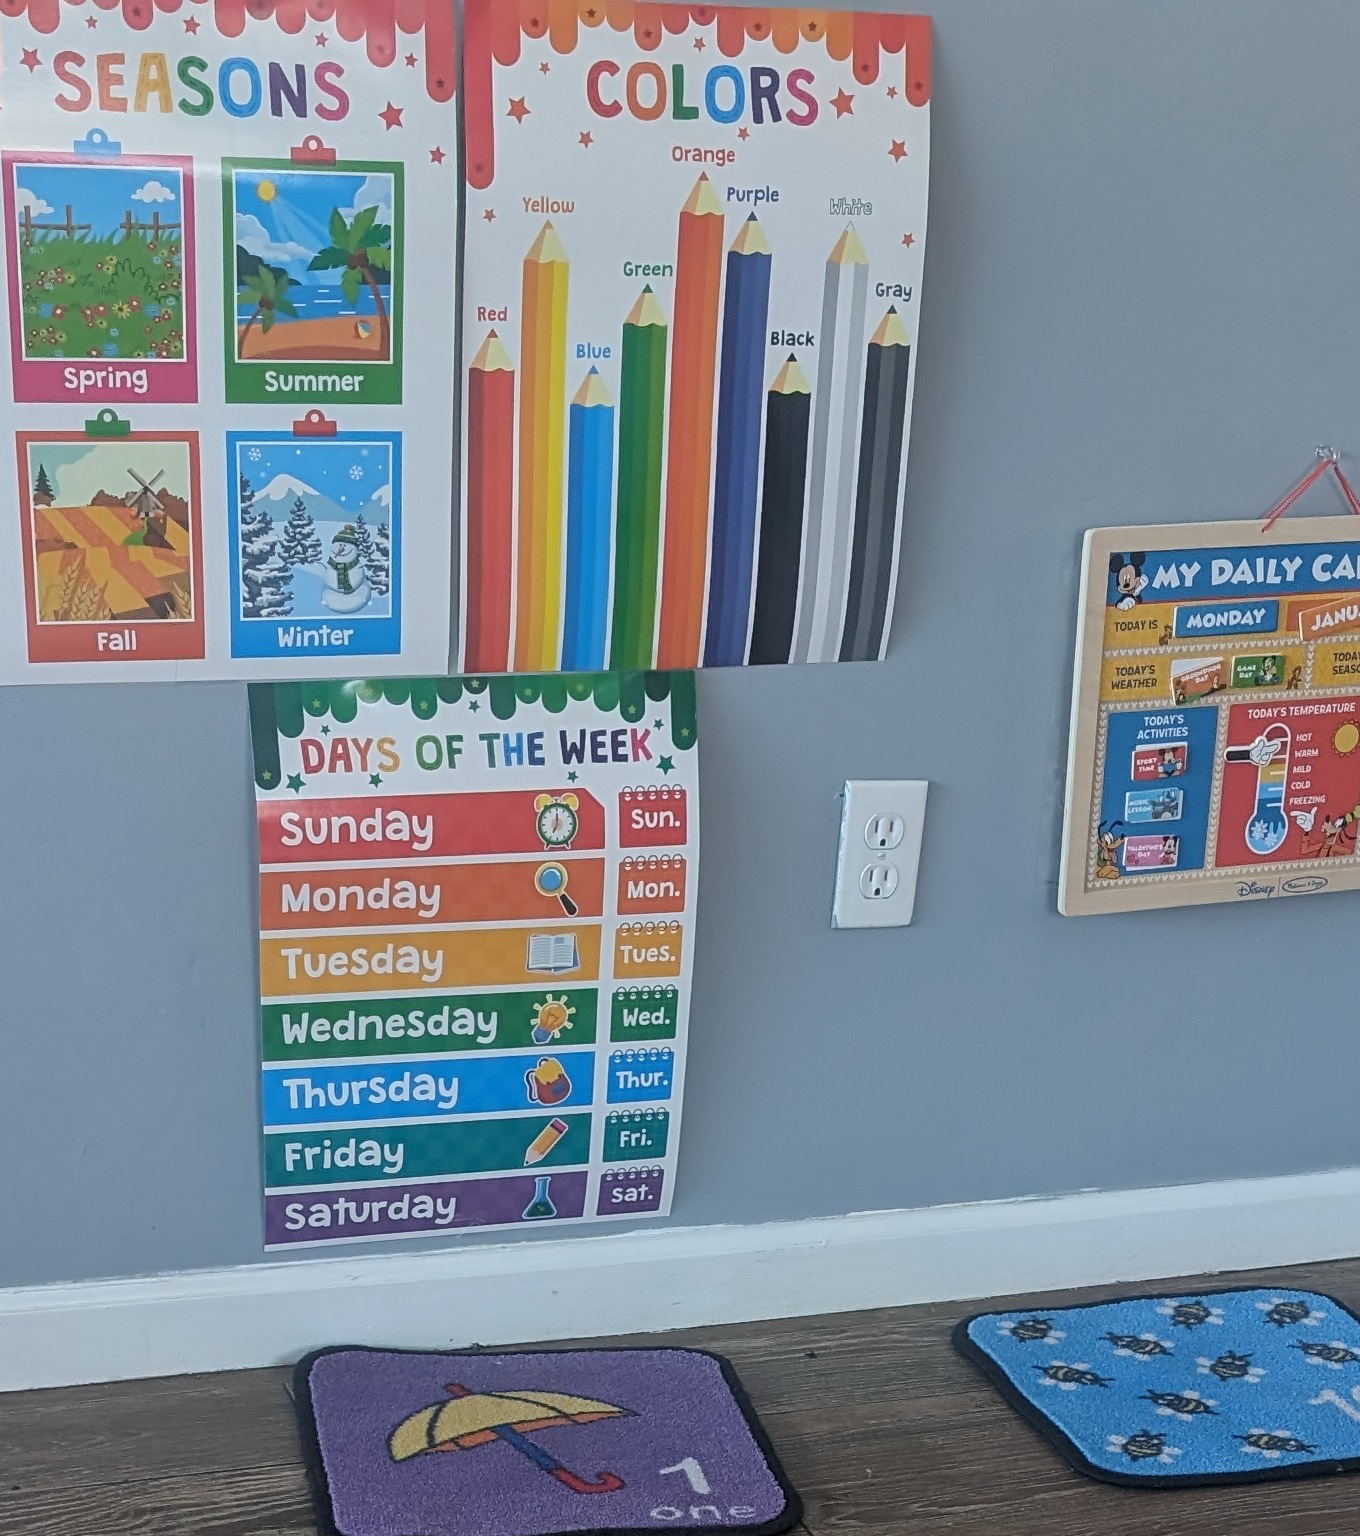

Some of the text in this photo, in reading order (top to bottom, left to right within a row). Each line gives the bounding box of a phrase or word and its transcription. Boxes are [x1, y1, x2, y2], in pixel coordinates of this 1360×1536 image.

[53, 50, 350, 121] SEASONS
[586, 59, 819, 126] COLORS
[671, 146, 736, 166] Orange
[522, 196, 575, 214] Yellow
[726, 186, 780, 206] Purple
[829, 198, 873, 216] White
[623, 261, 673, 278] Green
[875, 282, 913, 302] Gray
[477, 306, 508, 322] Red
[770, 330, 815, 348] Black
[576, 343, 612, 359] Blue
[63, 366, 149, 393] Spring
[264, 371, 364, 392] Summer
[1152, 562, 1202, 590] MY
[1211, 555, 1303, 586] DAILY
[1114, 620, 1158, 632] TODAY IS
[1186, 607, 1266, 629] MONDAY
[97, 630, 137, 651] Fall
[278, 626, 354, 647] Winter
[1115, 665, 1156, 677] TODAY'S
[1237, 664, 1256, 673] GAME
[1111, 678, 1158, 691] WEATHER
[1248, 702, 1356, 719] TODAY'S TEMPERATURE
[1144, 714, 1184, 727] TODAY'S
[1137, 727, 1189, 740] ACTIVITIES
[1296, 733, 1312, 742] HOT
[299, 728, 654, 775] DAYS OF THE WEEK
[1295, 749, 1319, 757] WARM
[1293, 765, 1311, 773] MILD
[1291, 781, 1311, 789] COLD
[1289, 795, 1325, 805] FREEZING
[631, 808, 681, 829] Sun.
[280, 807, 434, 851] Sunday
[281, 879, 441, 918] Monday
[627, 880, 681, 899] Mon.
[1235, 881, 1275, 897] Disney
[281, 944, 444, 982] Tuesday
[620, 945, 676, 964] Tues.
[282, 1005, 498, 1045] Wednesday
[622, 1008, 671, 1027] Wed.
[616, 1070, 669, 1090] Thur.
[282, 1071, 459, 1109] Thursday
[619, 1131, 653, 1148] Fri.
[284, 1138, 404, 1174] Friday
[659, 1457, 711, 1495] 1
[650, 1504, 757, 1521] one
